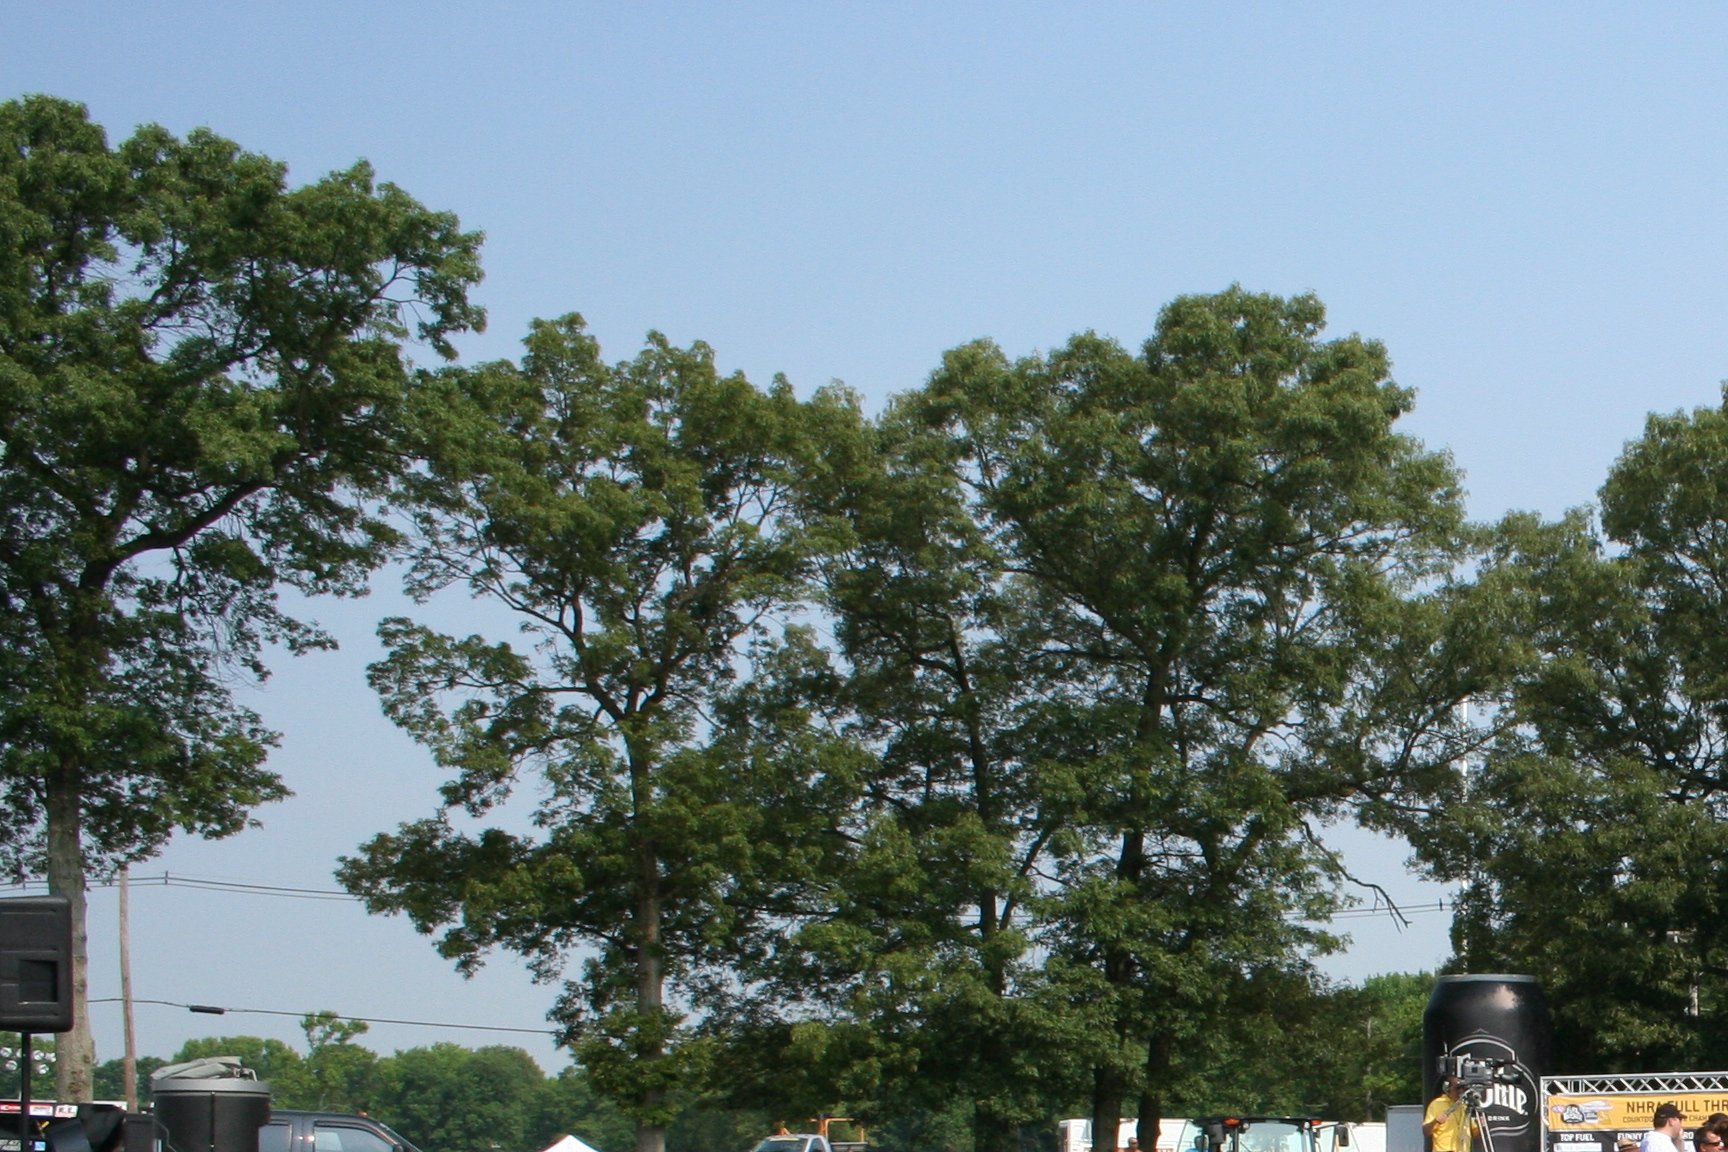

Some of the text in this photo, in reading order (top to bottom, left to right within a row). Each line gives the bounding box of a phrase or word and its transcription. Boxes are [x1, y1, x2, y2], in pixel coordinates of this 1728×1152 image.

[1560, 1133, 1594, 1142] TOP FUEL
[1618, 1132, 1642, 1141] FUNNY
